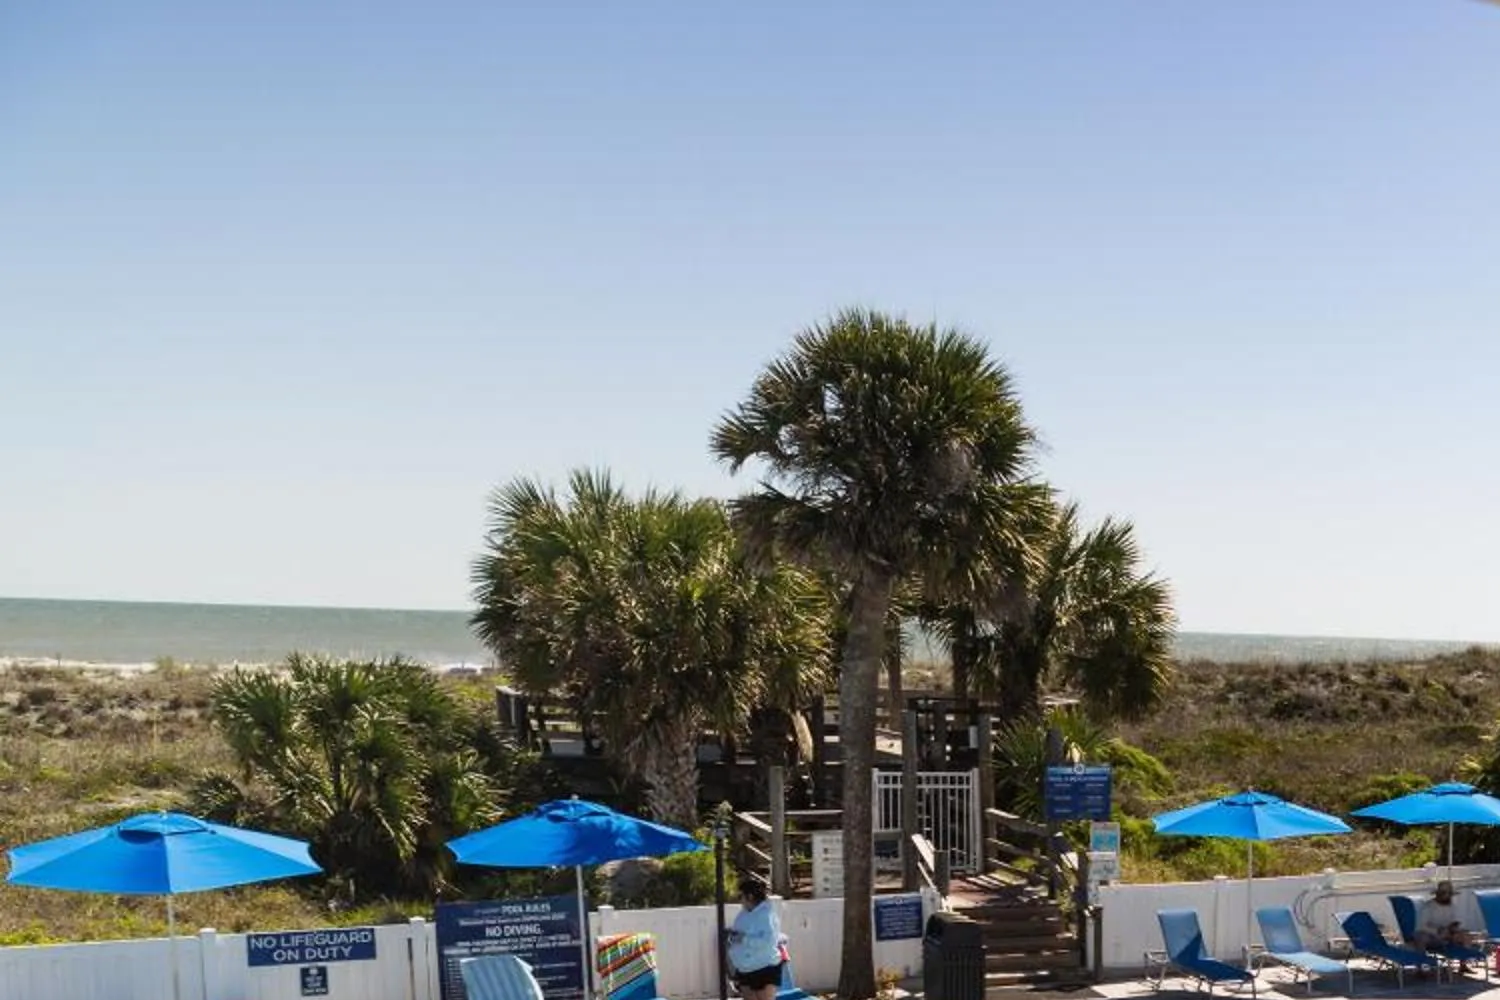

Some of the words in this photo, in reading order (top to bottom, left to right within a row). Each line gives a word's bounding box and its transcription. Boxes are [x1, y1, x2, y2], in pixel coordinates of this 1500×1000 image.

[485, 925, 501, 937] NO
[251, 936, 276, 949] NO
[281, 931, 371, 947] LIFEGUARD
[273, 949, 299, 961] ON
[305, 946, 352, 960] DUTY
